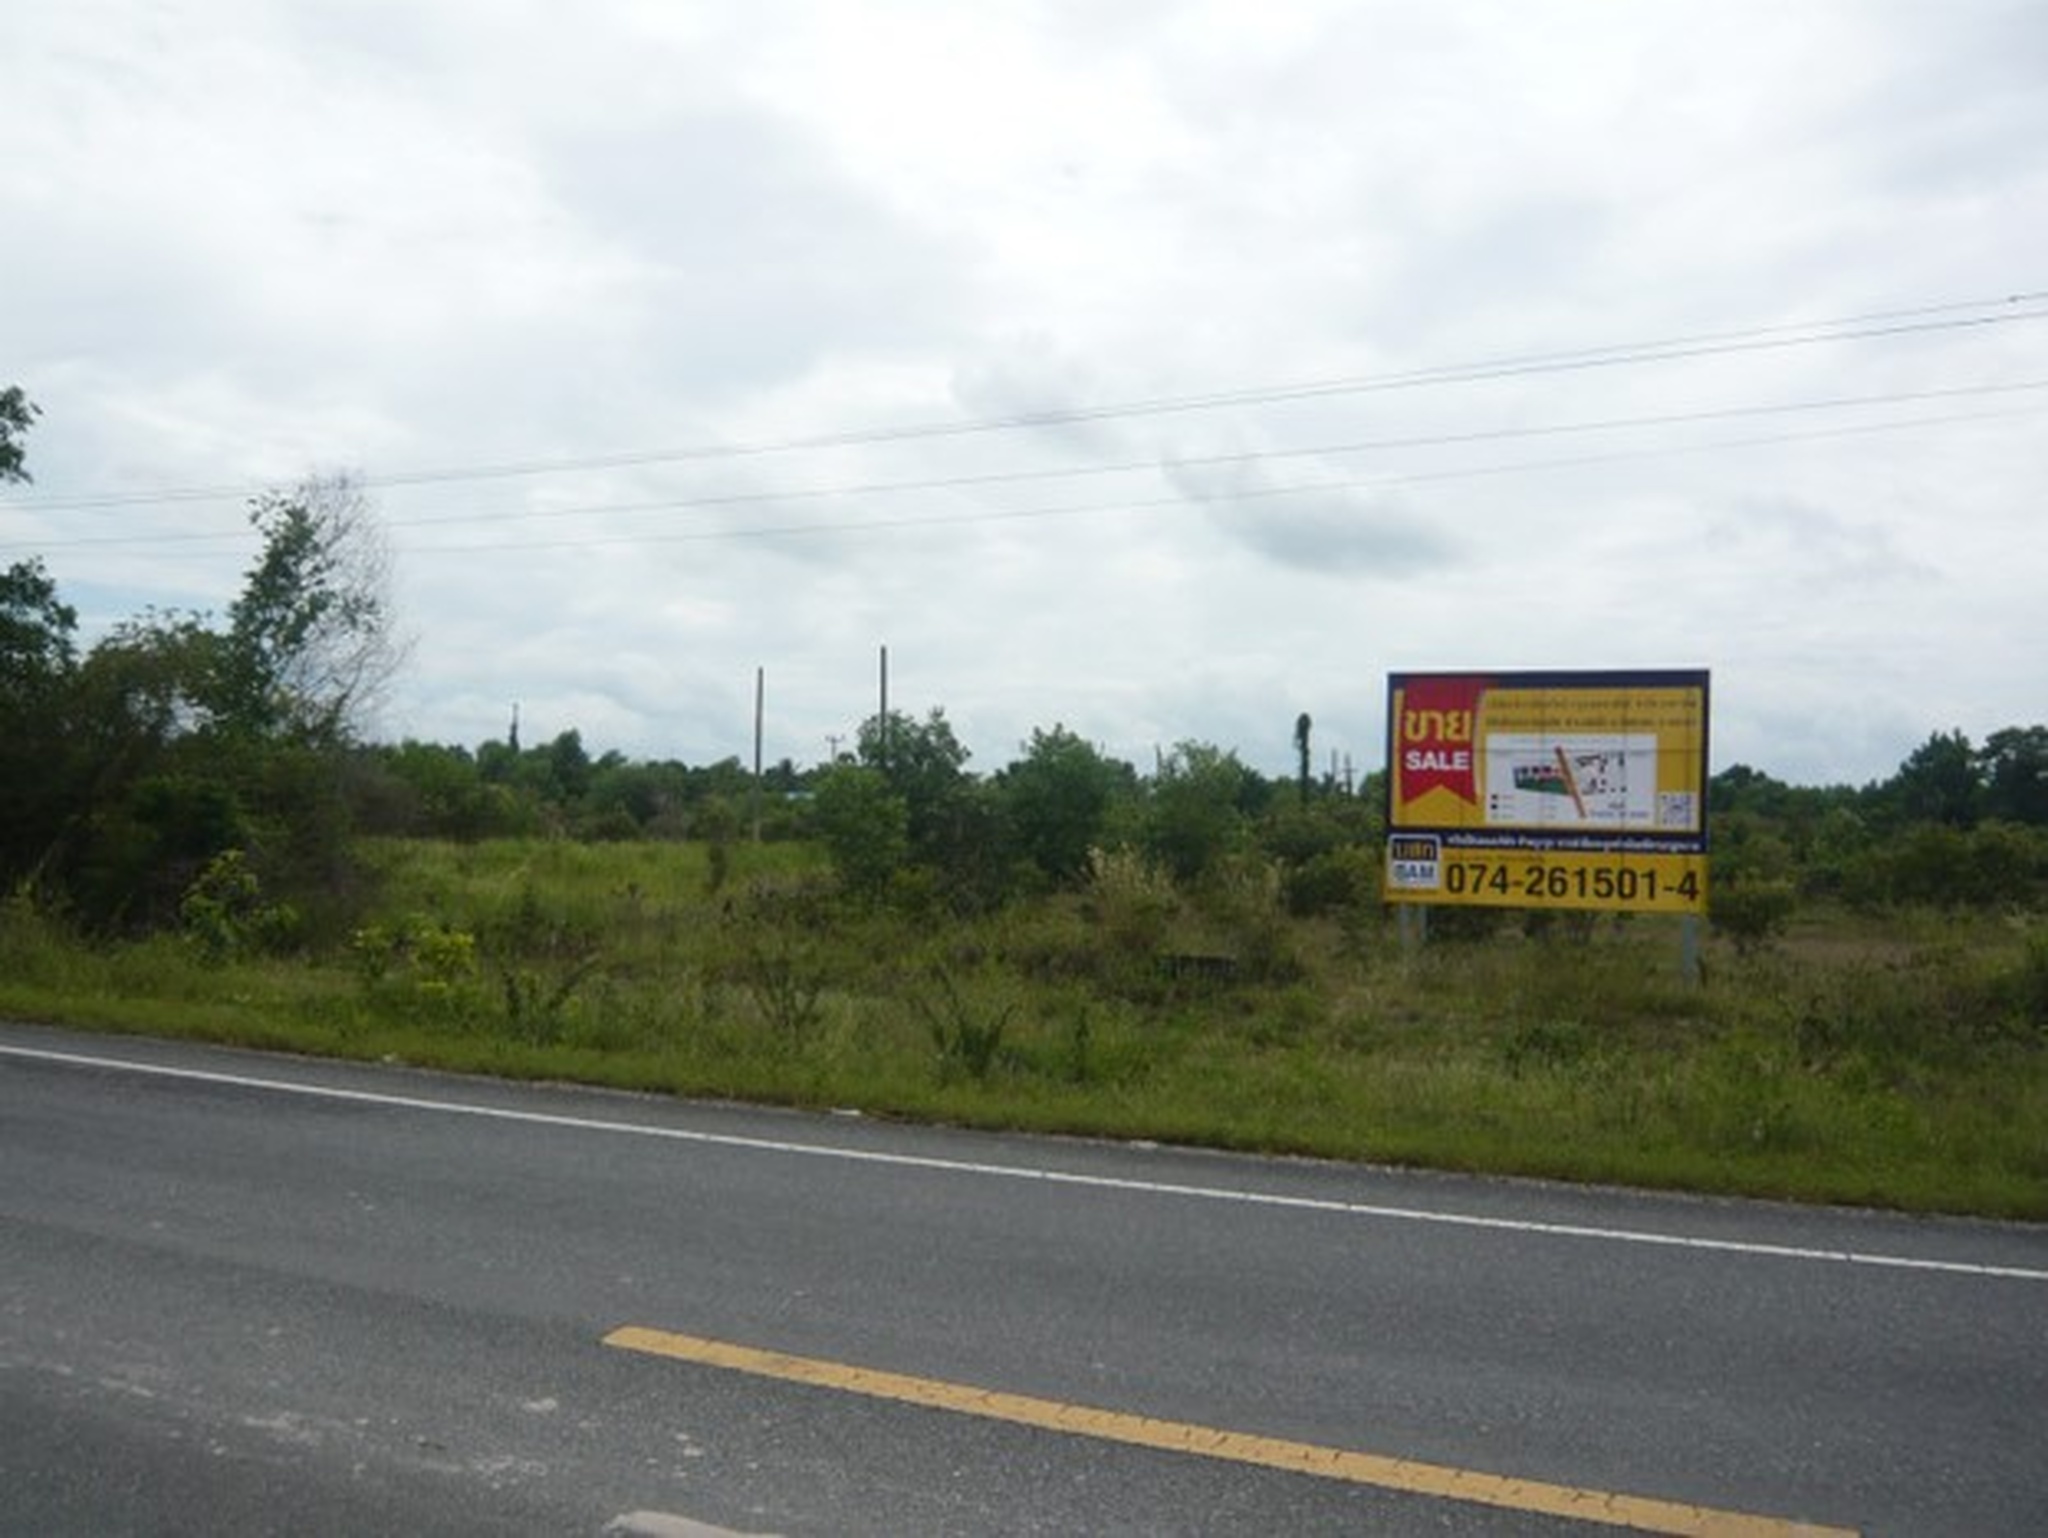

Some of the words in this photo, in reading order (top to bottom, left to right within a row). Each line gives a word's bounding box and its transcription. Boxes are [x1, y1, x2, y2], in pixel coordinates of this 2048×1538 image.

[1405, 710, 1471, 742] ขาย
[1405, 750, 1470, 771] SALE
[1446, 862, 1700, 901] 074-261501-4
